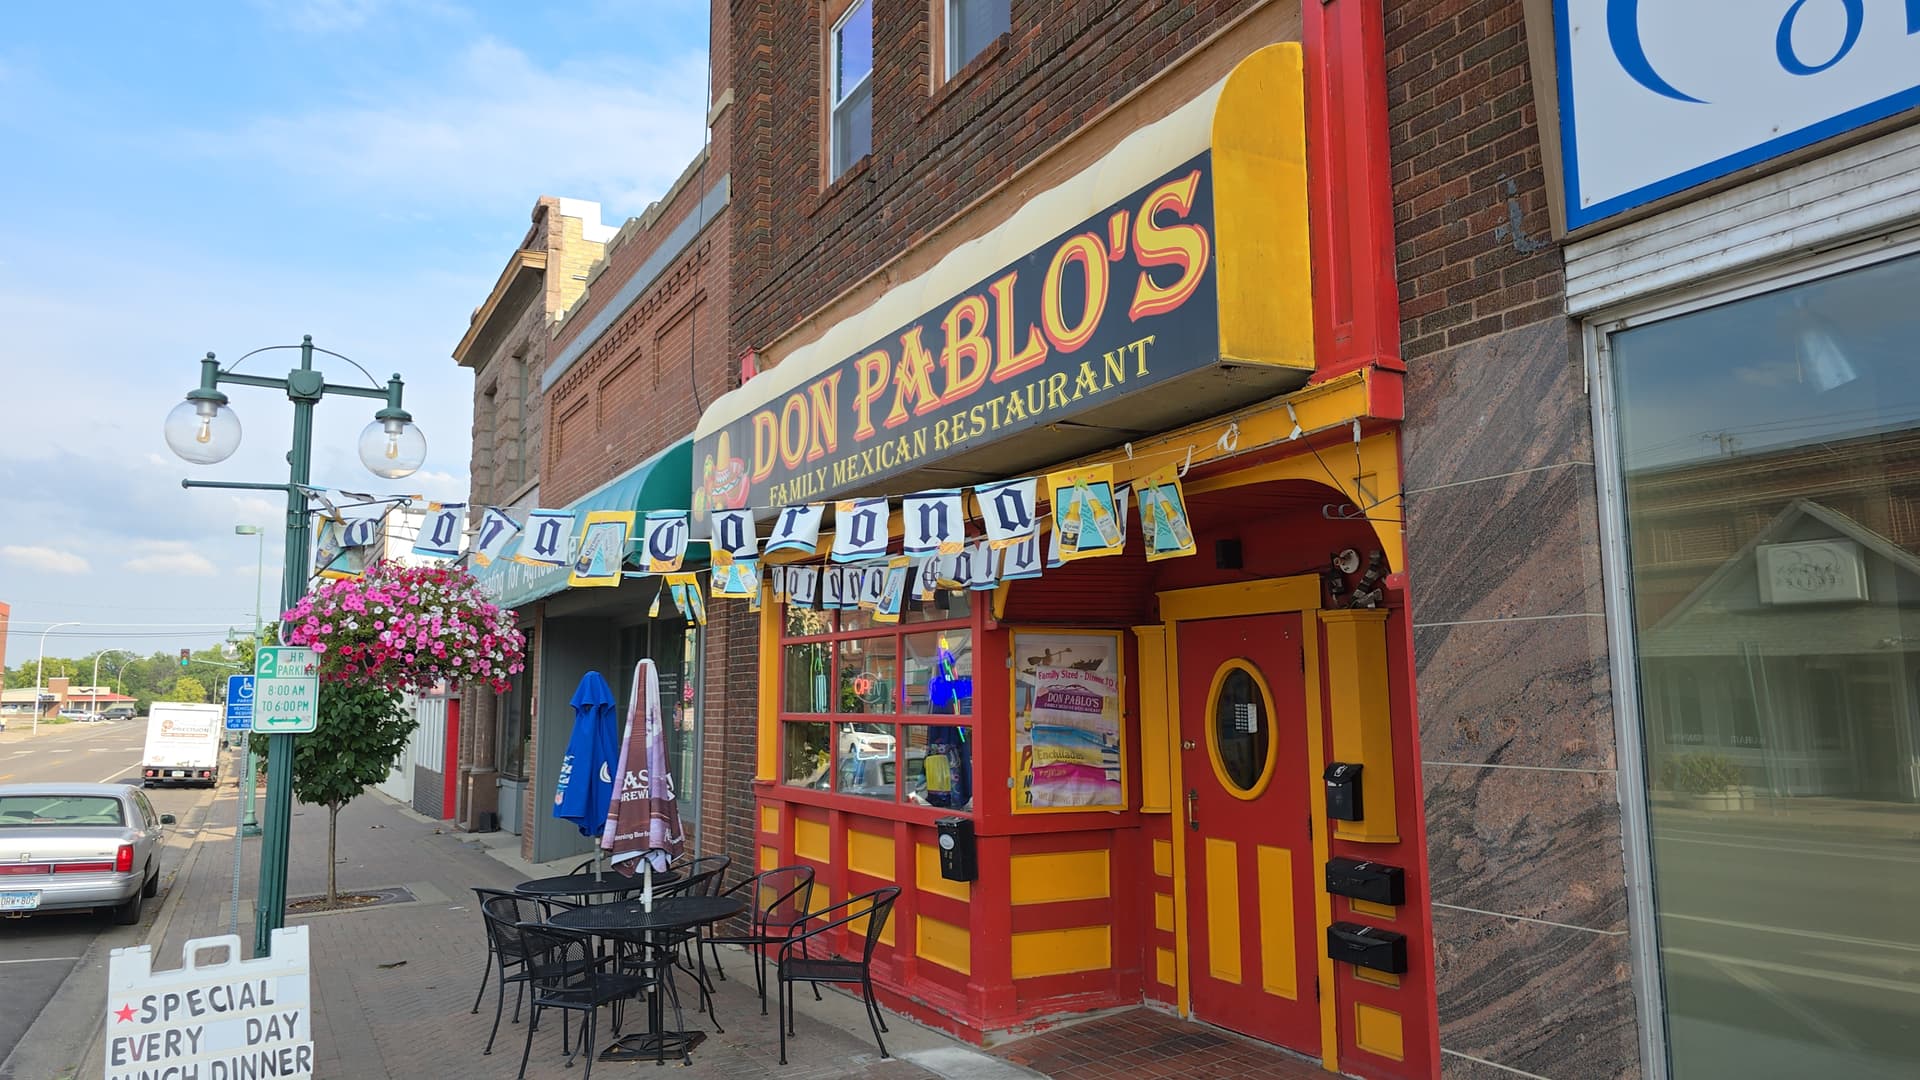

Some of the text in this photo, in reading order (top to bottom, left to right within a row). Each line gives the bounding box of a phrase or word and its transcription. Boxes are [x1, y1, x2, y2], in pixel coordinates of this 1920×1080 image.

[752, 168, 1210, 484] DON PABLO'S
[769, 335, 1156, 507] FAMILY MEXICAN RESTAURANT
[260, 652, 304, 674] 2 HR
[278, 665, 315, 676] PARKIG
[1061, 671, 1079, 680] Sized
[268, 685, 305, 696] 8:00 AM
[854, 678, 882, 696] OPEN
[262, 701, 273, 712] TO
[275, 701, 296, 712] 6:00
[297, 701, 309, 712] PM
[1047, 692, 1064, 704] DON
[1064, 695, 1100, 709] PABLO'S
[140, 979, 275, 1025] SPECIAL
[111, 1011, 299, 1067] EVERY DAY
[211, 1045, 312, 1080] DINNER
